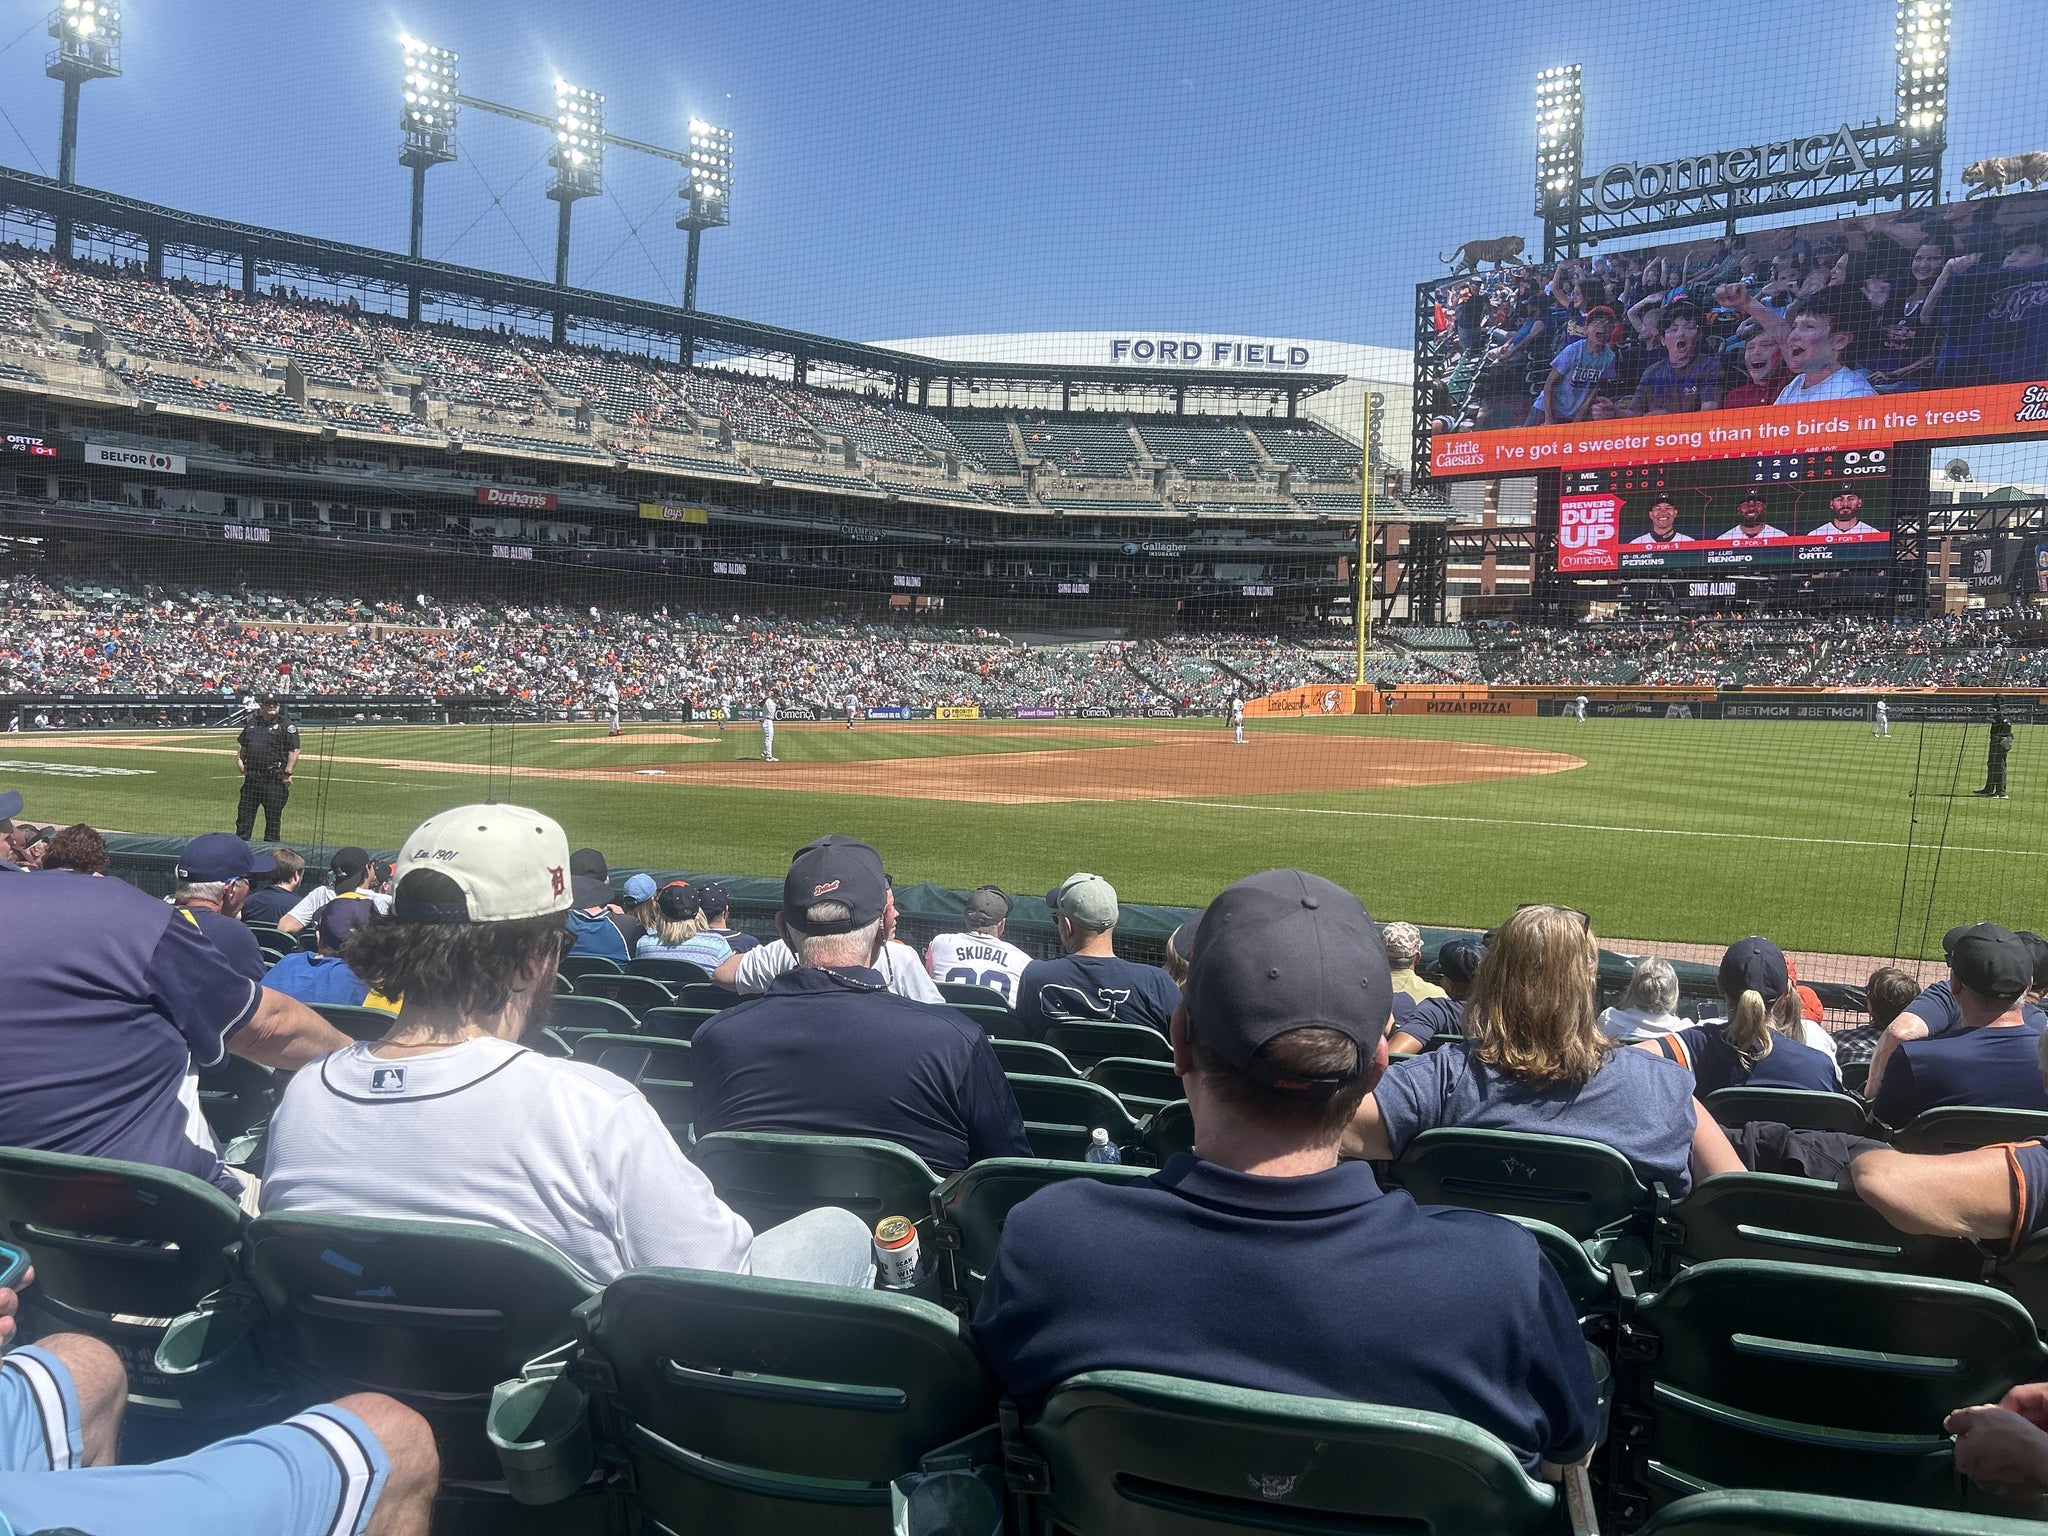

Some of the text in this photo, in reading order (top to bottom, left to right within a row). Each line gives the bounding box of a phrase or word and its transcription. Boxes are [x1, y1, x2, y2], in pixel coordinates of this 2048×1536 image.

[1662, 181, 1793, 220] PARK
[1111, 339, 1310, 366] FORD FIELD
[1495, 407, 1982, 460] I've got a sweeter song than the birds in the trees
[6, 435, 44, 446] ORTIZ
[36, 447, 53, 456] 0-1
[1446, 441, 1479, 455] Little
[101, 450, 147, 465] BELFOR
[1436, 453, 1484, 468] Caesars
[1843, 467, 1852, 475] 0
[1853, 465, 1887, 474] OUTS
[488, 489, 547, 505] Dunham's
[1562, 500, 1615, 510] BREWERS
[1562, 508, 1615, 525] DUE
[224, 524, 270, 542] SING ALONG
[1560, 524, 1615, 549] UP
[492, 545, 533, 560] SING ALONG
[1142, 542, 1187, 552] Gallagher
[1622, 558, 1665, 566] PERKINS
[1707, 554, 1753, 563] RENGIFO
[713, 562, 746, 575] SING ALONG
[894, 576, 921, 587] SING ALONG
[1058, 584, 1090, 594] SING ALONG
[1242, 586, 1274, 596] SING ALONG
[1689, 582, 1736, 596] SING ALONG
[692, 708, 725, 720] bet36
[1427, 702, 1511, 714] PIZZA! PIZZA!
[1738, 706, 1790, 716] BETMGM
[1808, 707, 1864, 717] BETMGM
[432, 849, 459, 861] 1901
[956, 945, 1008, 968] SKUBAL
[896, 1257, 913, 1268] SCAN
[898, 1267, 914, 1278] WIN
